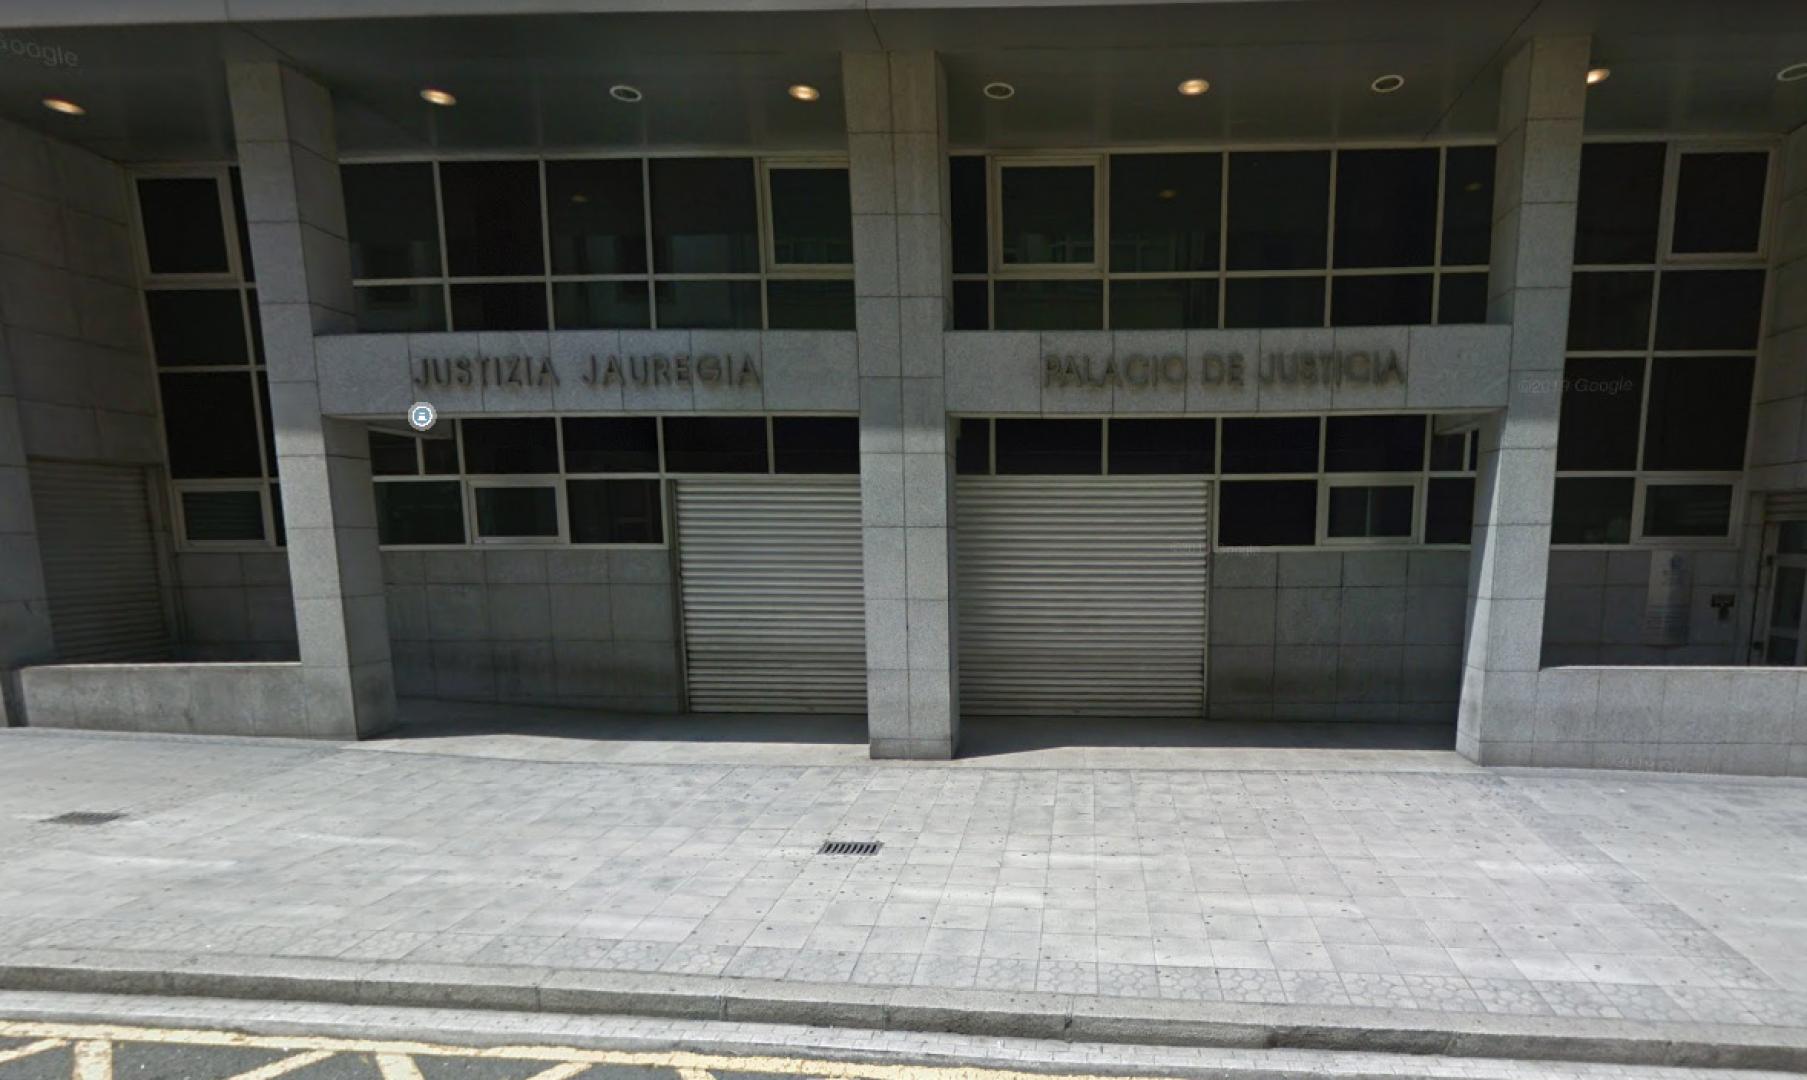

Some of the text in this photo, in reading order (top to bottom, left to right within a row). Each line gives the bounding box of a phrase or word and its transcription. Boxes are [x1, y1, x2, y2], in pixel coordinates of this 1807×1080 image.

[414, 352, 763, 388] JUSTIZIA JAUREGIA
[1044, 349, 1406, 388] PALACIO DE JUSTICIA
